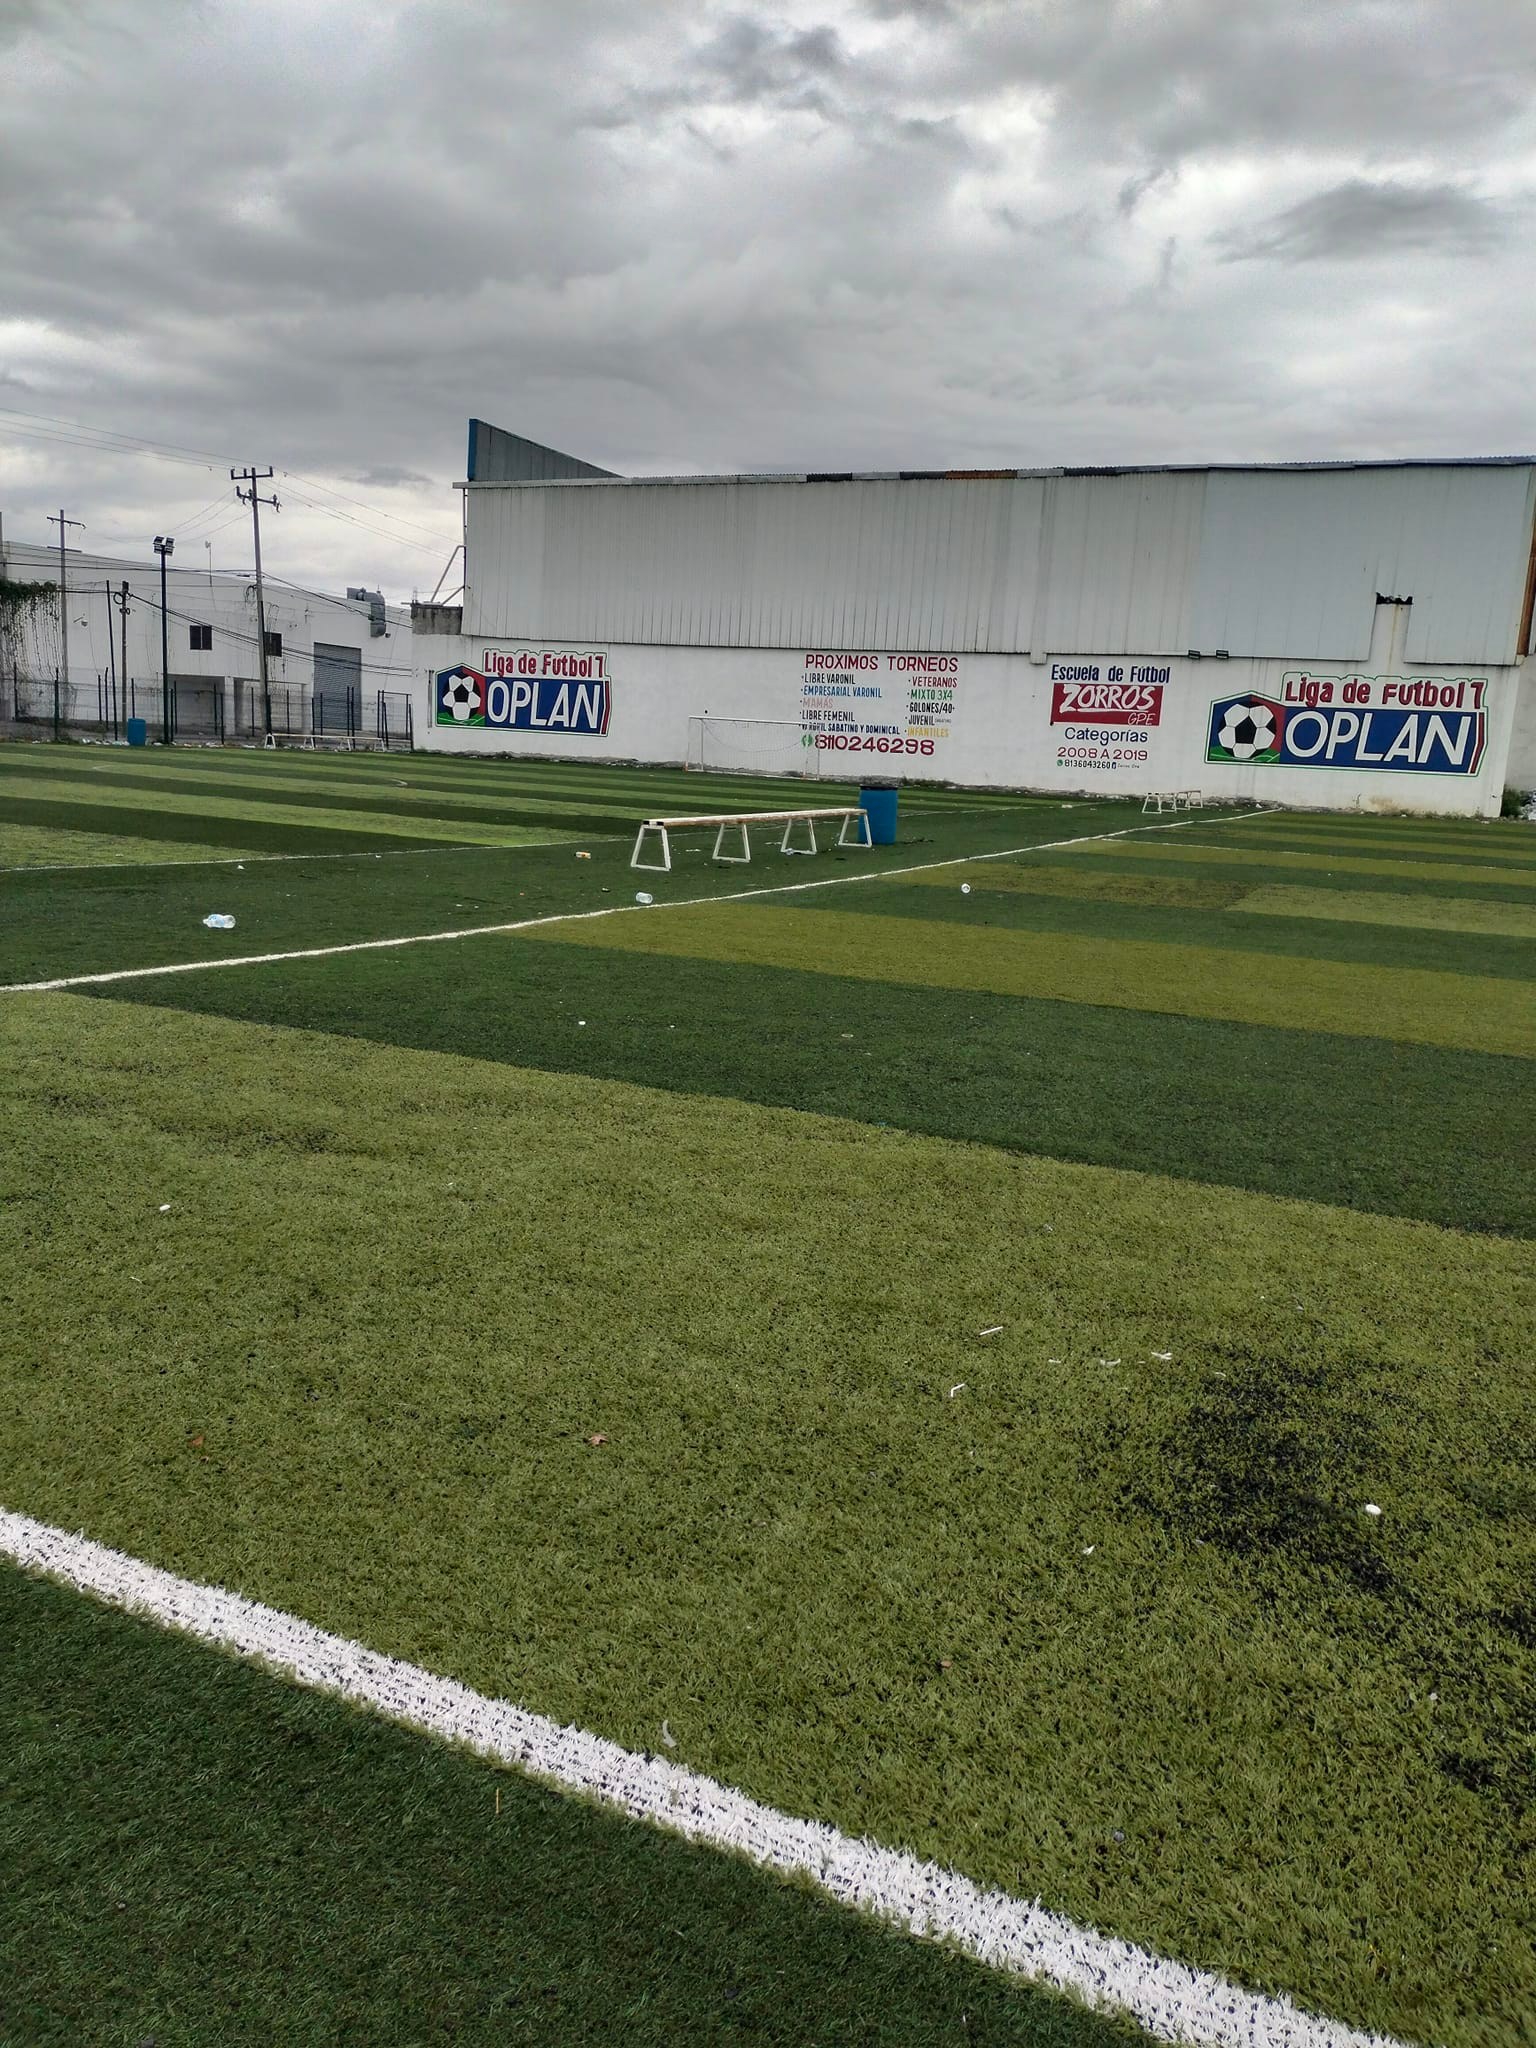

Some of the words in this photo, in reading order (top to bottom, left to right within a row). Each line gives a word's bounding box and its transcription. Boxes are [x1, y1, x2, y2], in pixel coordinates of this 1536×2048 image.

[484, 651, 514, 677] Liga
[518, 653, 537, 674] de
[542, 654, 593, 677] Futbol
[595, 656, 603, 678] 7
[805, 654, 879, 670] PROXIMOS
[887, 656, 958, 672] TORNEOS
[804, 673, 825, 683] LIBRE
[826, 673, 856, 685] VARONIL
[1051, 664, 1099, 680] Escuela
[1108, 666, 1124, 682] de
[912, 676, 958, 688] VETERANOS
[803, 685, 851, 697] EMPRESARIAL
[852, 687, 883, 698] VARONIL
[910, 689, 936, 700] MIXTO
[937, 690, 953, 701] 3X4
[1059, 683, 1155, 713] ZORROS
[1285, 677, 1334, 707] Liga
[1342, 678, 1370, 704] de
[1382, 681, 1466, 708] Futbol
[1470, 681, 1485, 710] 7
[487, 680, 601, 729] OPLAN
[802, 709, 822, 721] LIBRE
[823, 710, 855, 722] FEMENIL
[908, 715, 935, 726] JUVENIL
[1127, 712, 1156, 726] GPE
[828, 723, 858, 733] SABATINO
[860, 724, 865, 733] Y
[865, 725, 901, 735] DOMINICAL
[1064, 727, 1148, 746] Categorías
[1285, 711, 1473, 766] OPLAN
[814, 734, 935, 756] 8110246298
[1057, 747, 1098, 759] 2008
[1100, 748, 1110, 760] A
[1113, 749, 1148, 761] 2019
[1064, 760, 1111, 769] 8136043260
